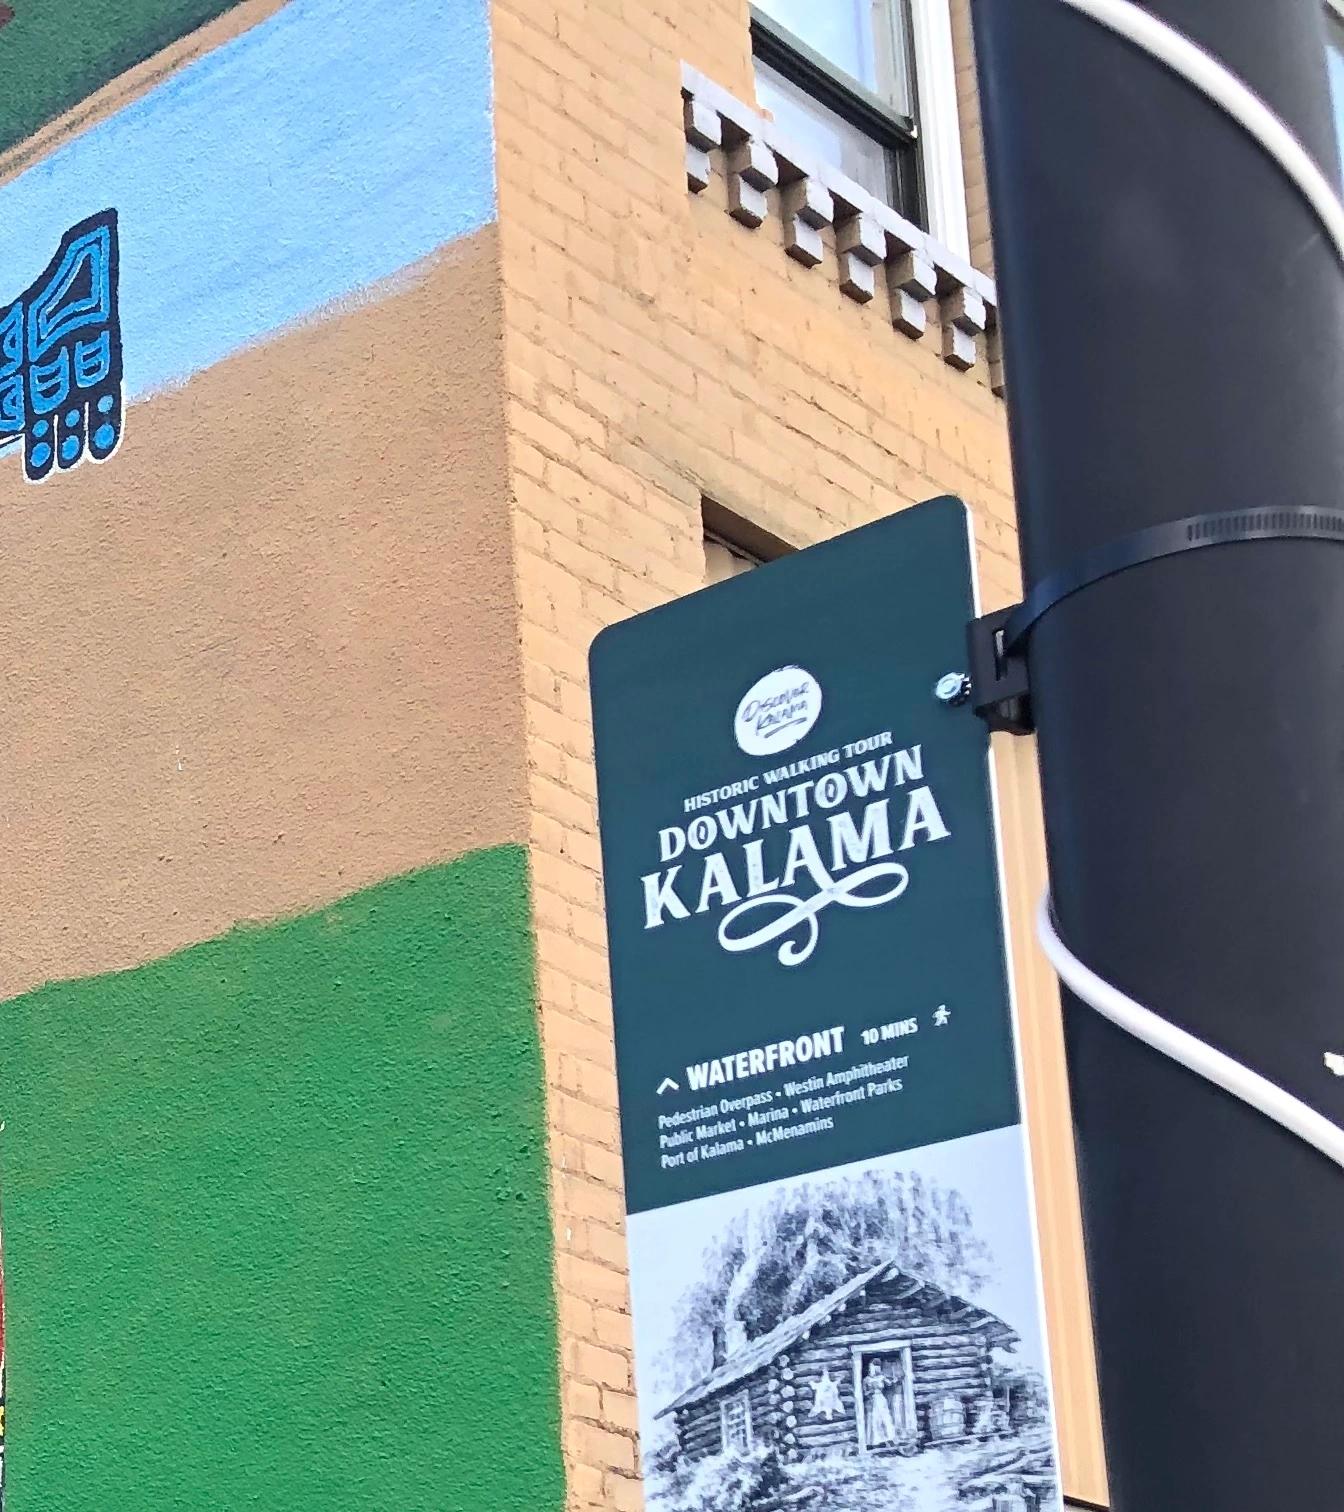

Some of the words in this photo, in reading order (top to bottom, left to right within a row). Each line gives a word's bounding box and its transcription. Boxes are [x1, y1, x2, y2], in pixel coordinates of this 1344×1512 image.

[658, 745, 924, 862] DOWNTOWN
[684, 776, 758, 812] HISTORIC
[763, 749, 840, 784] WALKING
[842, 732, 892, 758] TOUR
[640, 785, 951, 930] KALAMA
[686, 1026, 845, 1091] WATERFRONT
[860, 1027, 879, 1045] 10
[880, 1017, 918, 1040] MINS
[658, 1104, 718, 1129] Pedestrian
[719, 1090, 773, 1113] Overpass
[783, 1076, 824, 1097] Westin
[826, 1056, 908, 1086] Amphitheater
[659, 1129, 693, 1148] Public
[695, 1118, 736, 1140] Market
[747, 1107, 789, 1127] Marina
[800, 1087, 865, 1113] Waterfront
[866, 1078, 903, 1097] Parks
[661, 1151, 685, 1168] Port
[686, 1146, 699, 1163] of
[700, 1139, 744, 1159] Kalama
[755, 1117, 833, 1145] McMenamins
